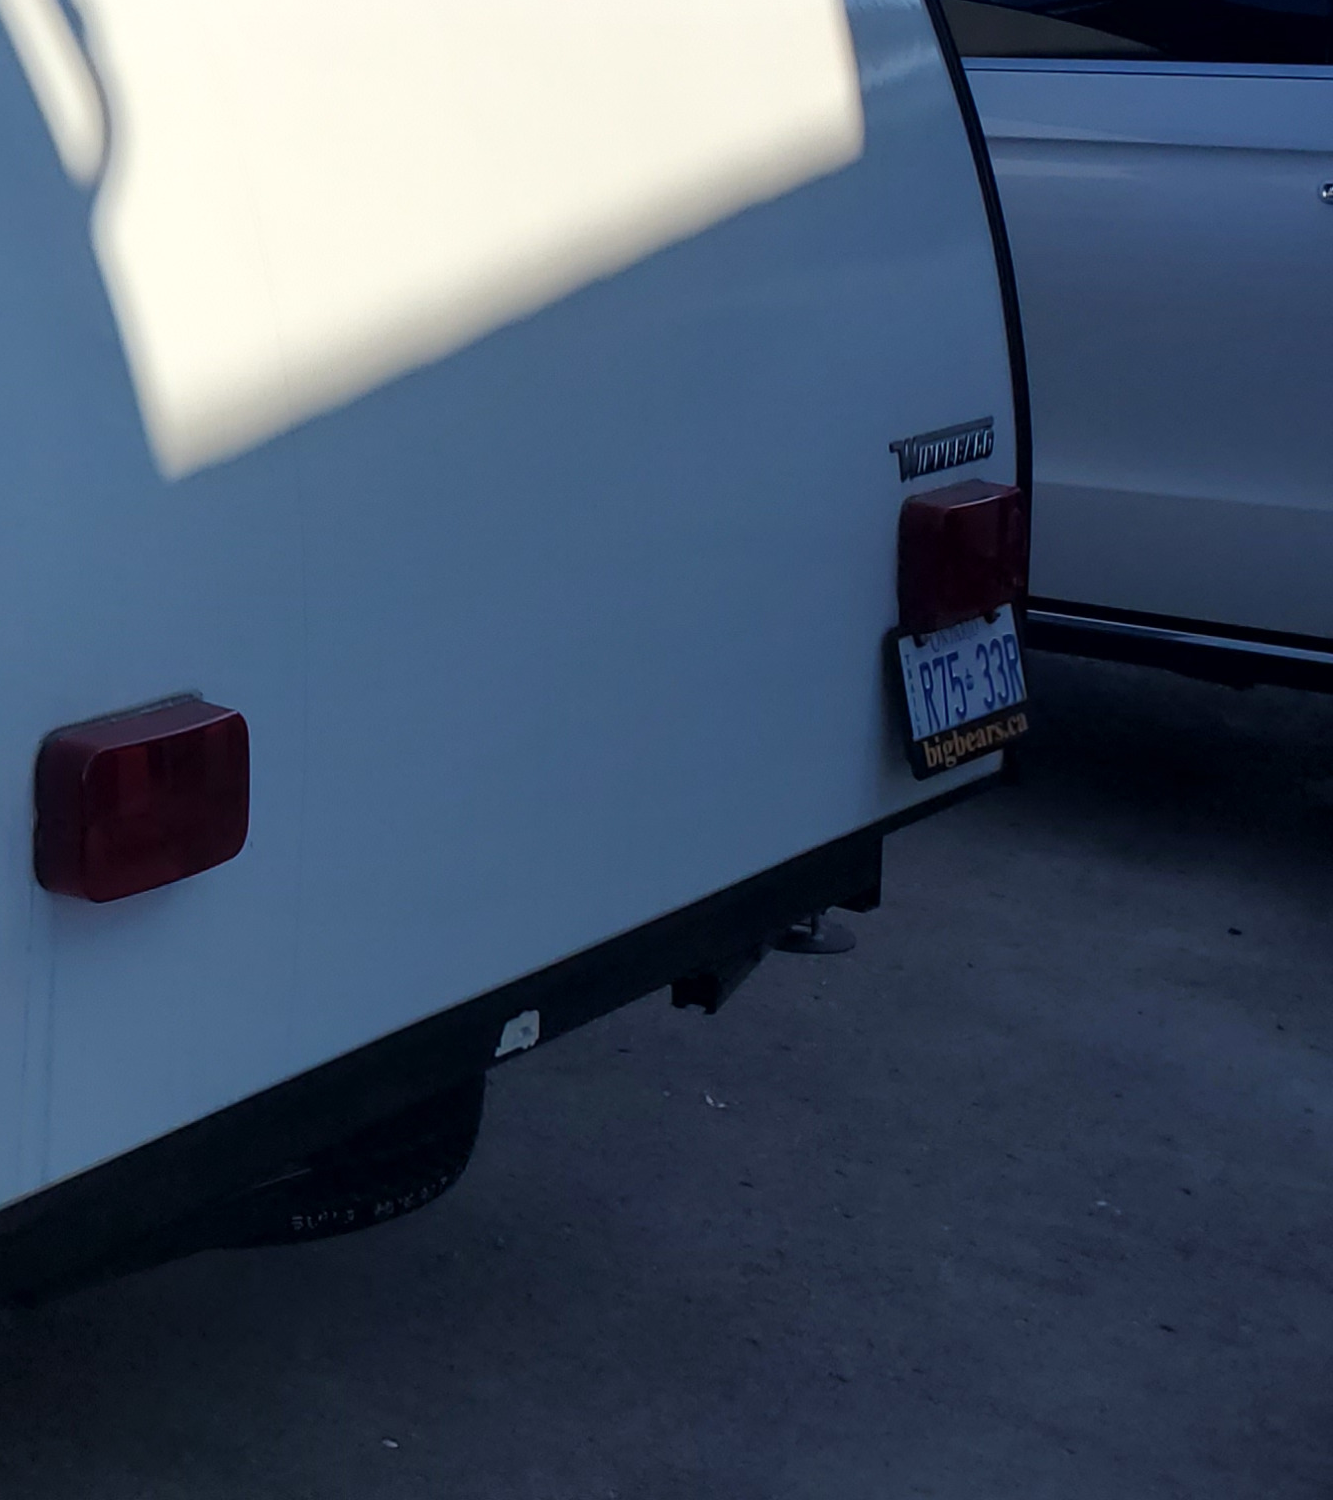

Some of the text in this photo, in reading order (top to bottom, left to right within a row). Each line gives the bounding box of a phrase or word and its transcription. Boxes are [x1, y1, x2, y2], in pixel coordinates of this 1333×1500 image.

[918, 633, 1027, 735] R75 33R
[922, 711, 1030, 768] bigbears.ca
